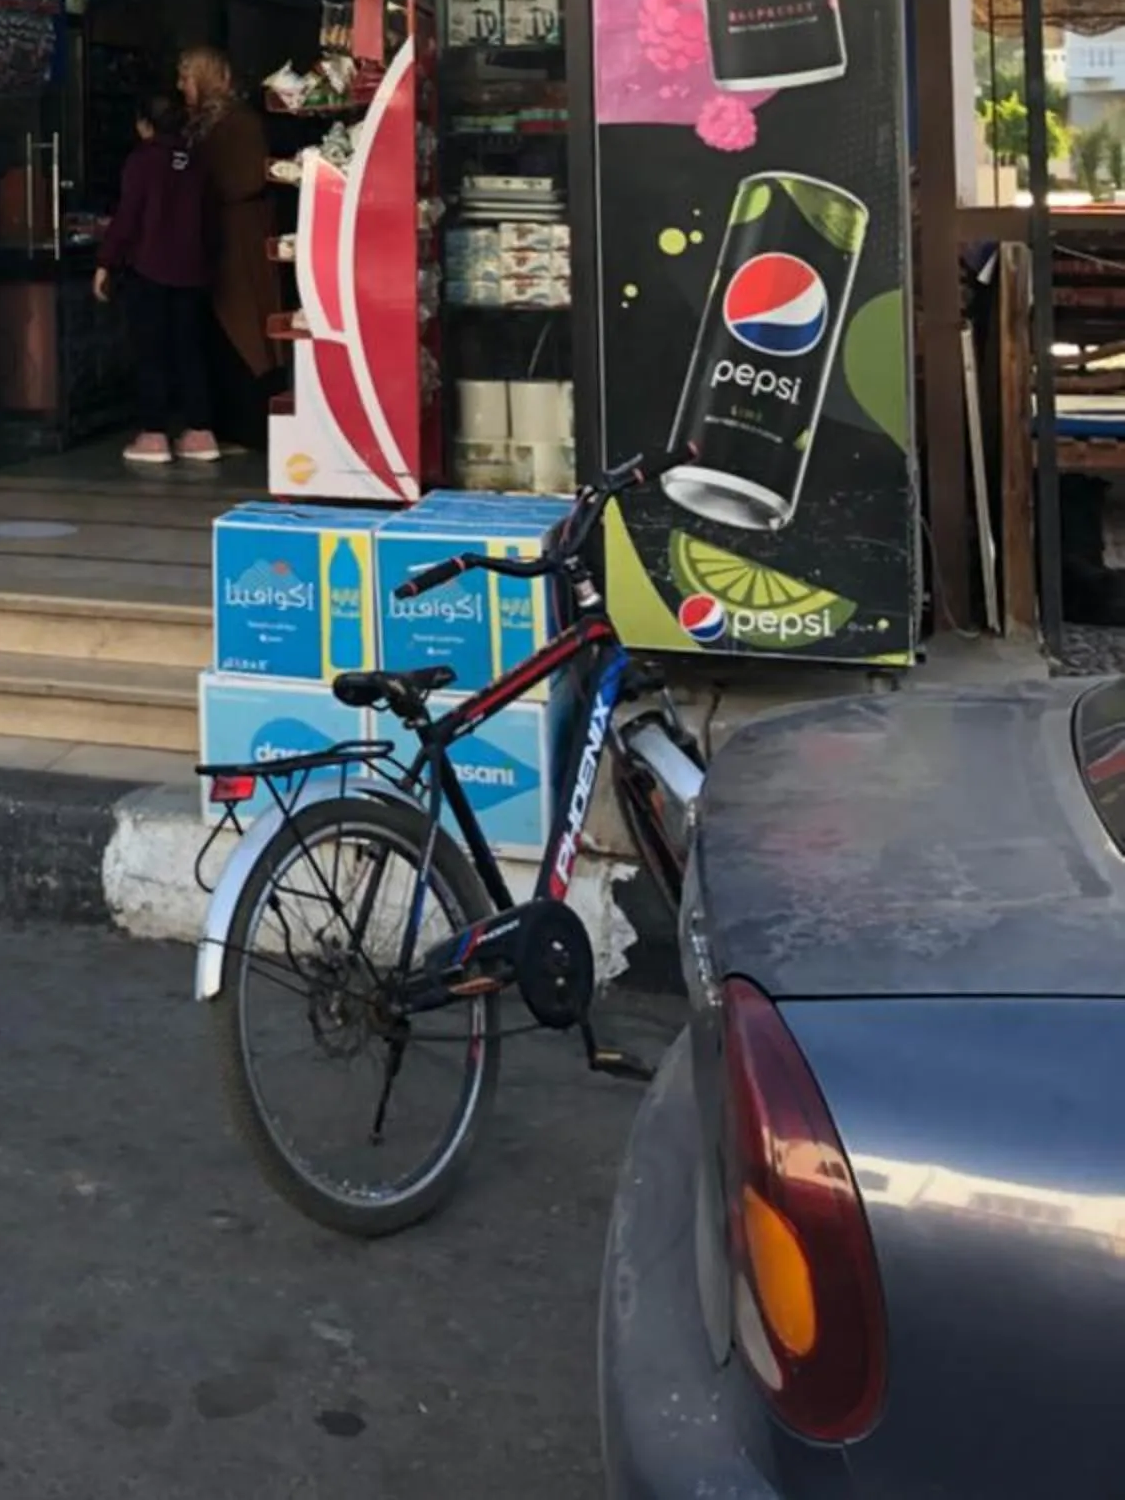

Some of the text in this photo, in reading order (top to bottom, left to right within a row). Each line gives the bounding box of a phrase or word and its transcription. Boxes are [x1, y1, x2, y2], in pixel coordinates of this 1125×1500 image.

[709, 360, 802, 405] pepsi
[732, 589, 832, 642] pepsi
[555, 691, 610, 885] PHOENIX
